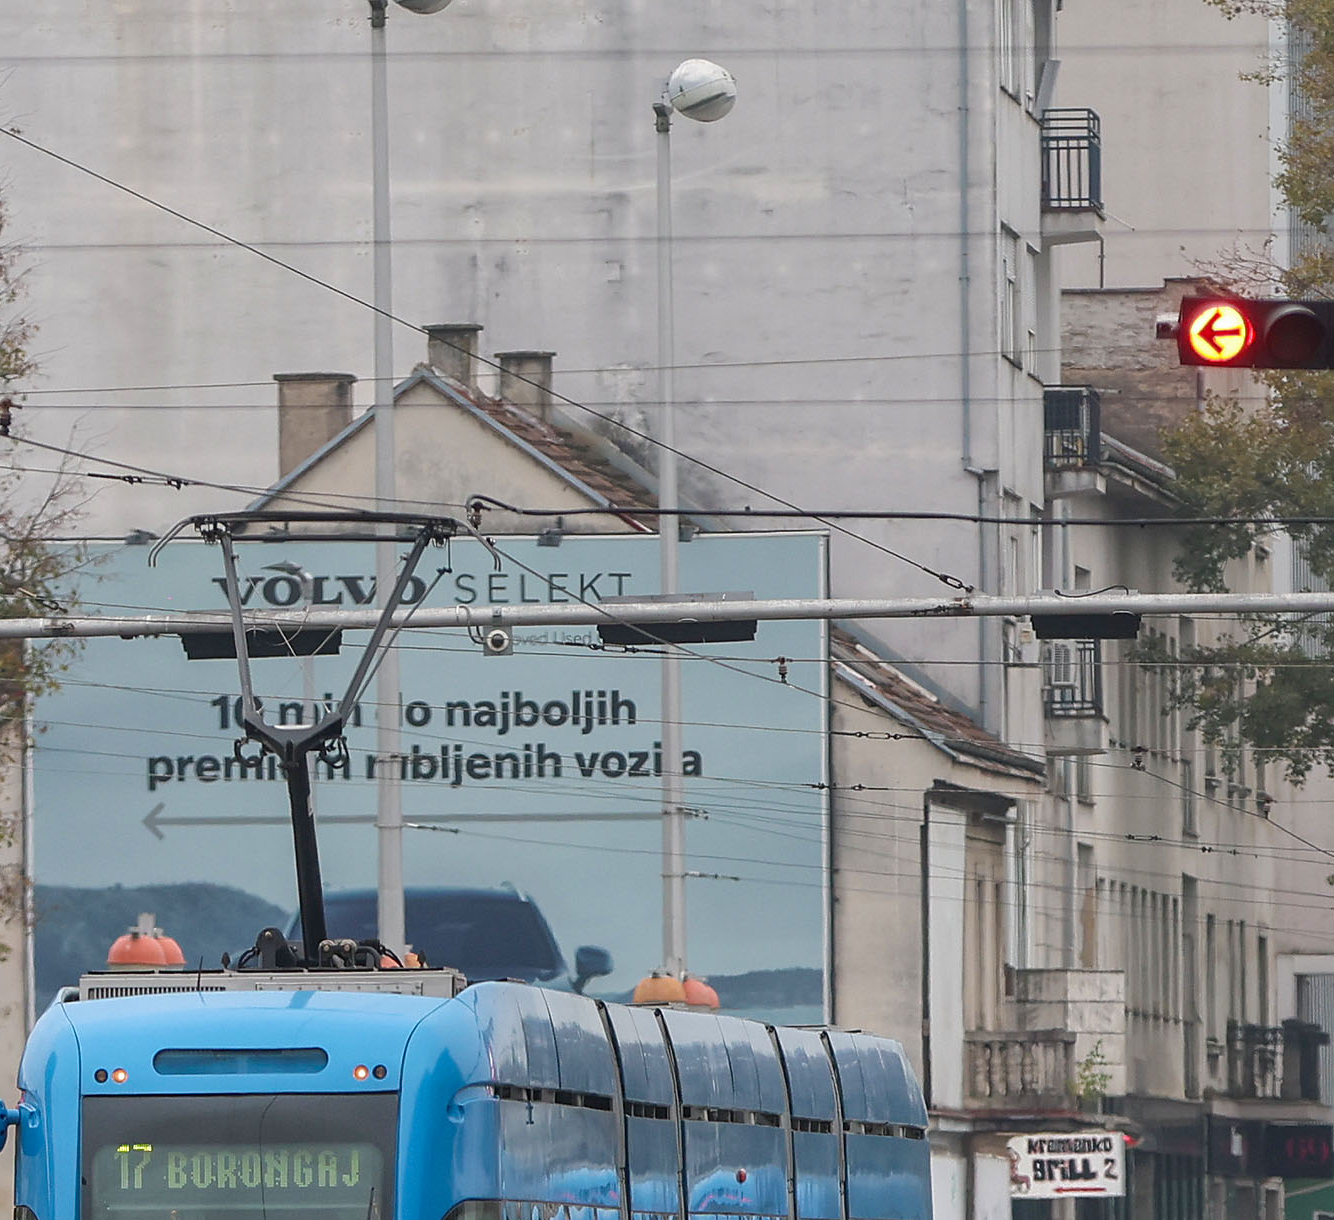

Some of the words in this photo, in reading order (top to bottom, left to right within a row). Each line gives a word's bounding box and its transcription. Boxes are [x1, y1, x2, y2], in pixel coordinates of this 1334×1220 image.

[454, 572, 632, 604] SELEKT
[375, 691, 432, 727] o
[446, 690, 637, 735] najboljih
[148, 748, 350, 791] premim
[575, 741, 703, 778] vozia
[114, 1144, 153, 1189] 17
[167, 1150, 360, 1189] BORONGAJ
[1104, 1158, 1118, 1180] 2
